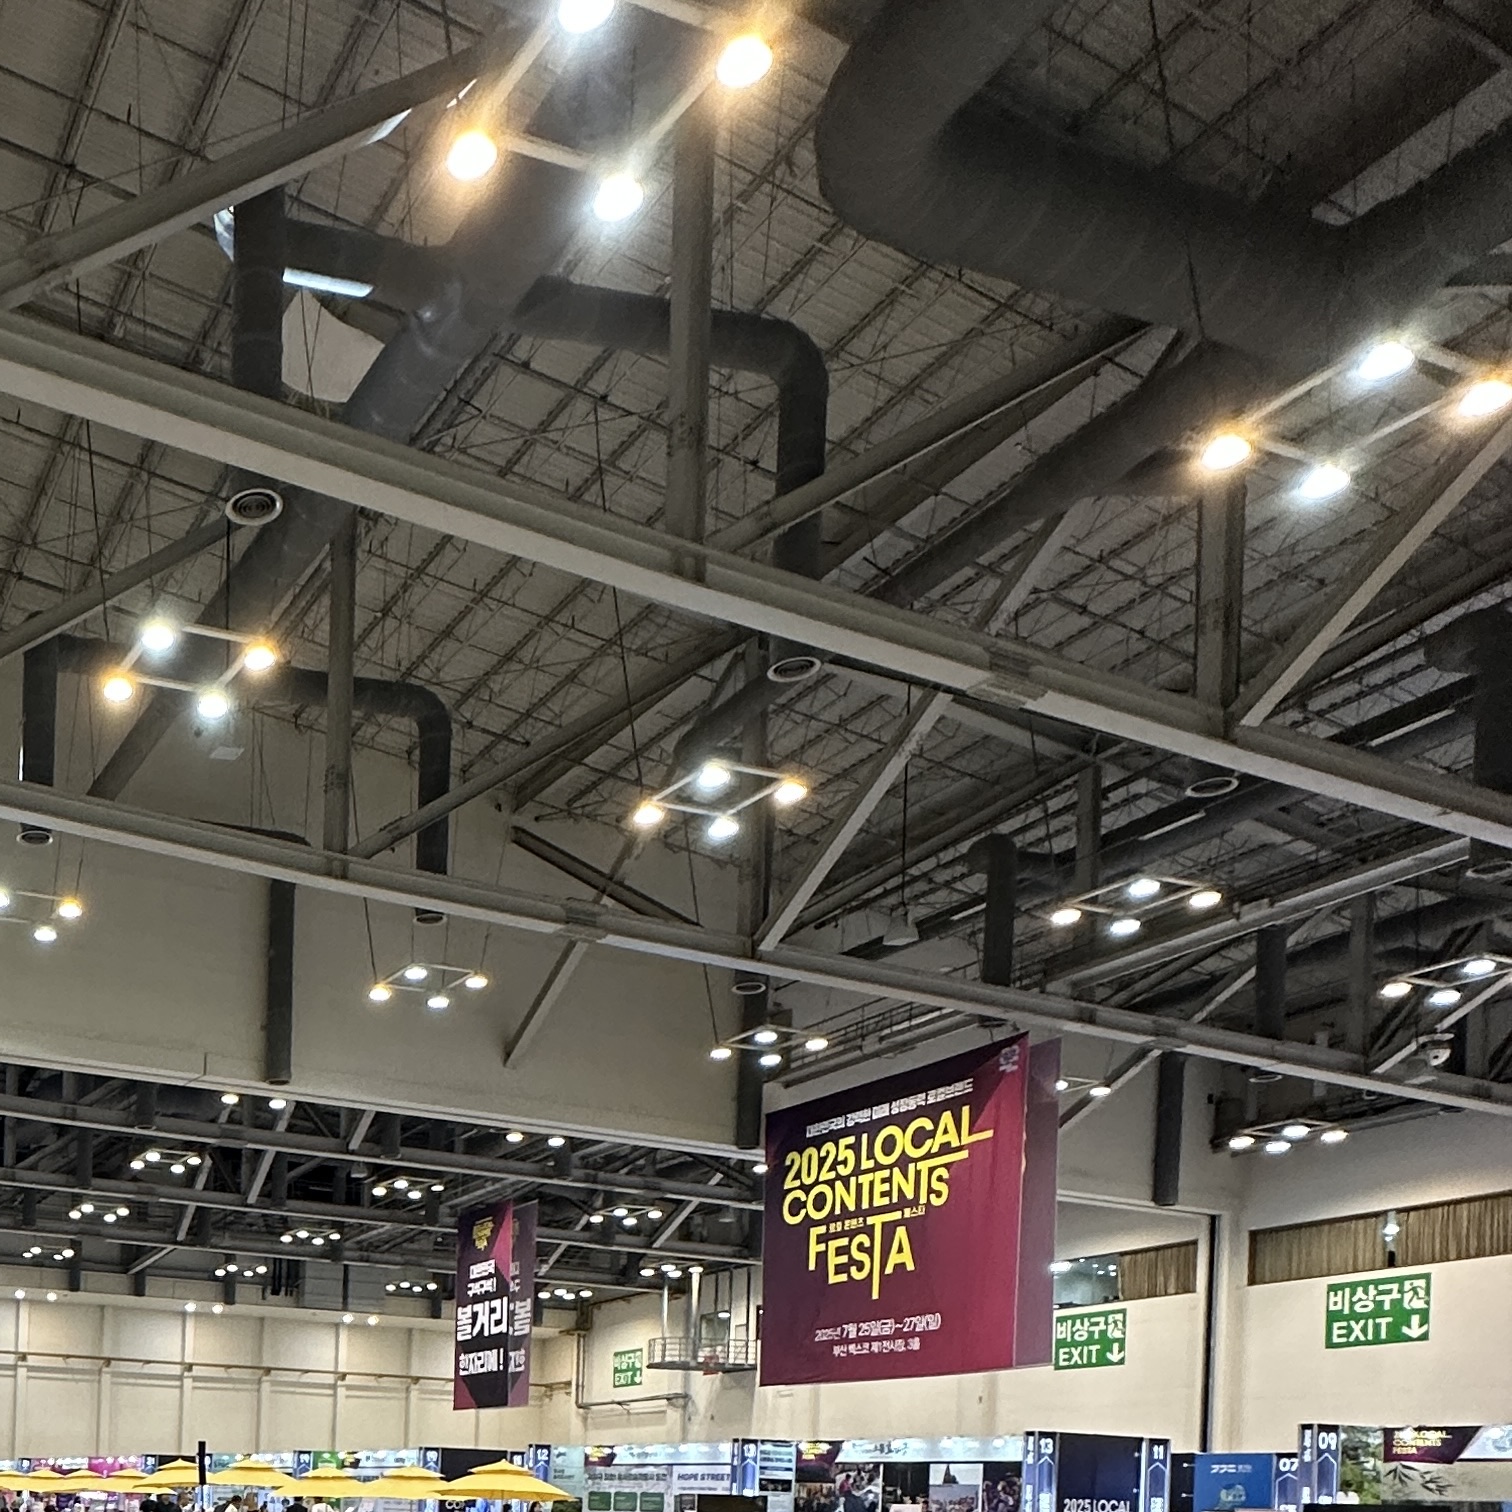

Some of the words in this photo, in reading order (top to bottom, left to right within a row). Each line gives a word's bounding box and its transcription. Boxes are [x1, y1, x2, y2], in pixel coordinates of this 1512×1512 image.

[783, 1136, 855, 1190] 2025
[860, 1105, 994, 1171] LOCAL
[782, 1150, 969, 1225] CONTENTS
[808, 1211, 916, 1300] FESTA
[1329, 1283, 1401, 1314] 비상구
[457, 1296, 509, 1341] 볼거리
[1056, 1316, 1106, 1342] 비상구
[1332, 1317, 1393, 1343] EXIT
[1059, 1345, 1100, 1366] EXIT
[1039, 1437, 1053, 1455] 13
[1318, 1432, 1337, 1450] 09
[1279, 1458, 1299, 1471] 07
